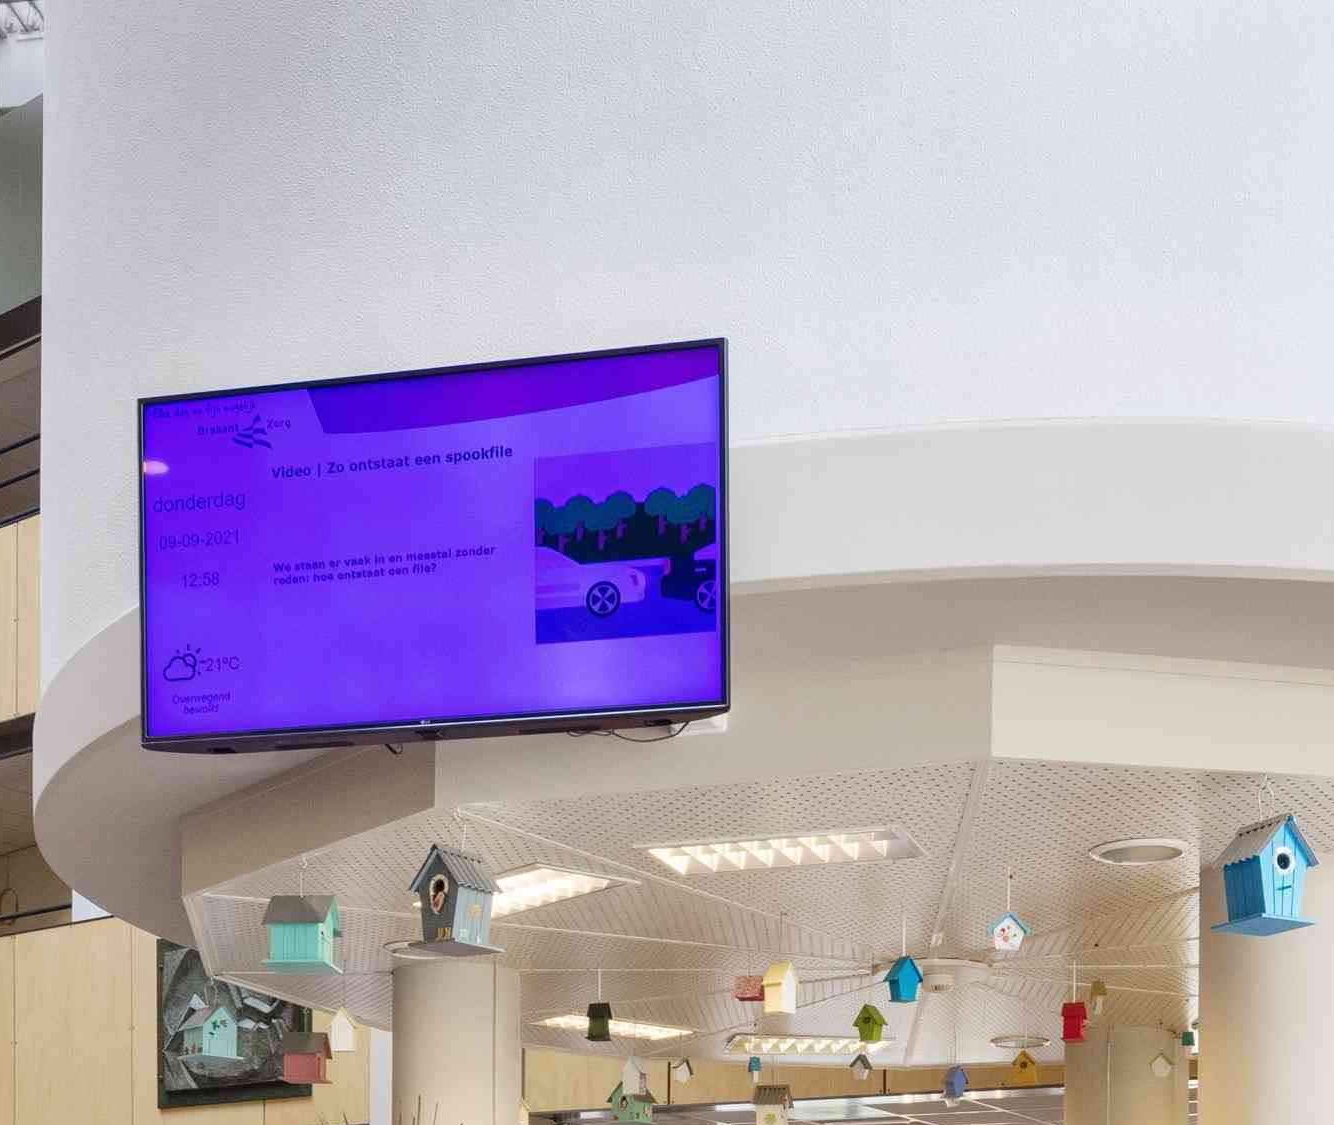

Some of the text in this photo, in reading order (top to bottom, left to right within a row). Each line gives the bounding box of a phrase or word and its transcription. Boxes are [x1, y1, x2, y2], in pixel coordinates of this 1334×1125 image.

[271, 465, 312, 479] Video
[326, 461, 345, 474] Zo
[349, 456, 410, 472] ontstaat
[414, 454, 441, 466] een
[445, 446, 513, 465] spookfile
[152, 490, 246, 513] donderdag
[158, 529, 240, 550] 09-09-2021
[273, 545, 495, 573] We staan er vaak in en meestal zonder
[313, 572, 333, 583] hoe
[337, 568, 385, 580] ontstaat
[388, 566, 409, 576] een
[412, 563, 437, 574] file?
